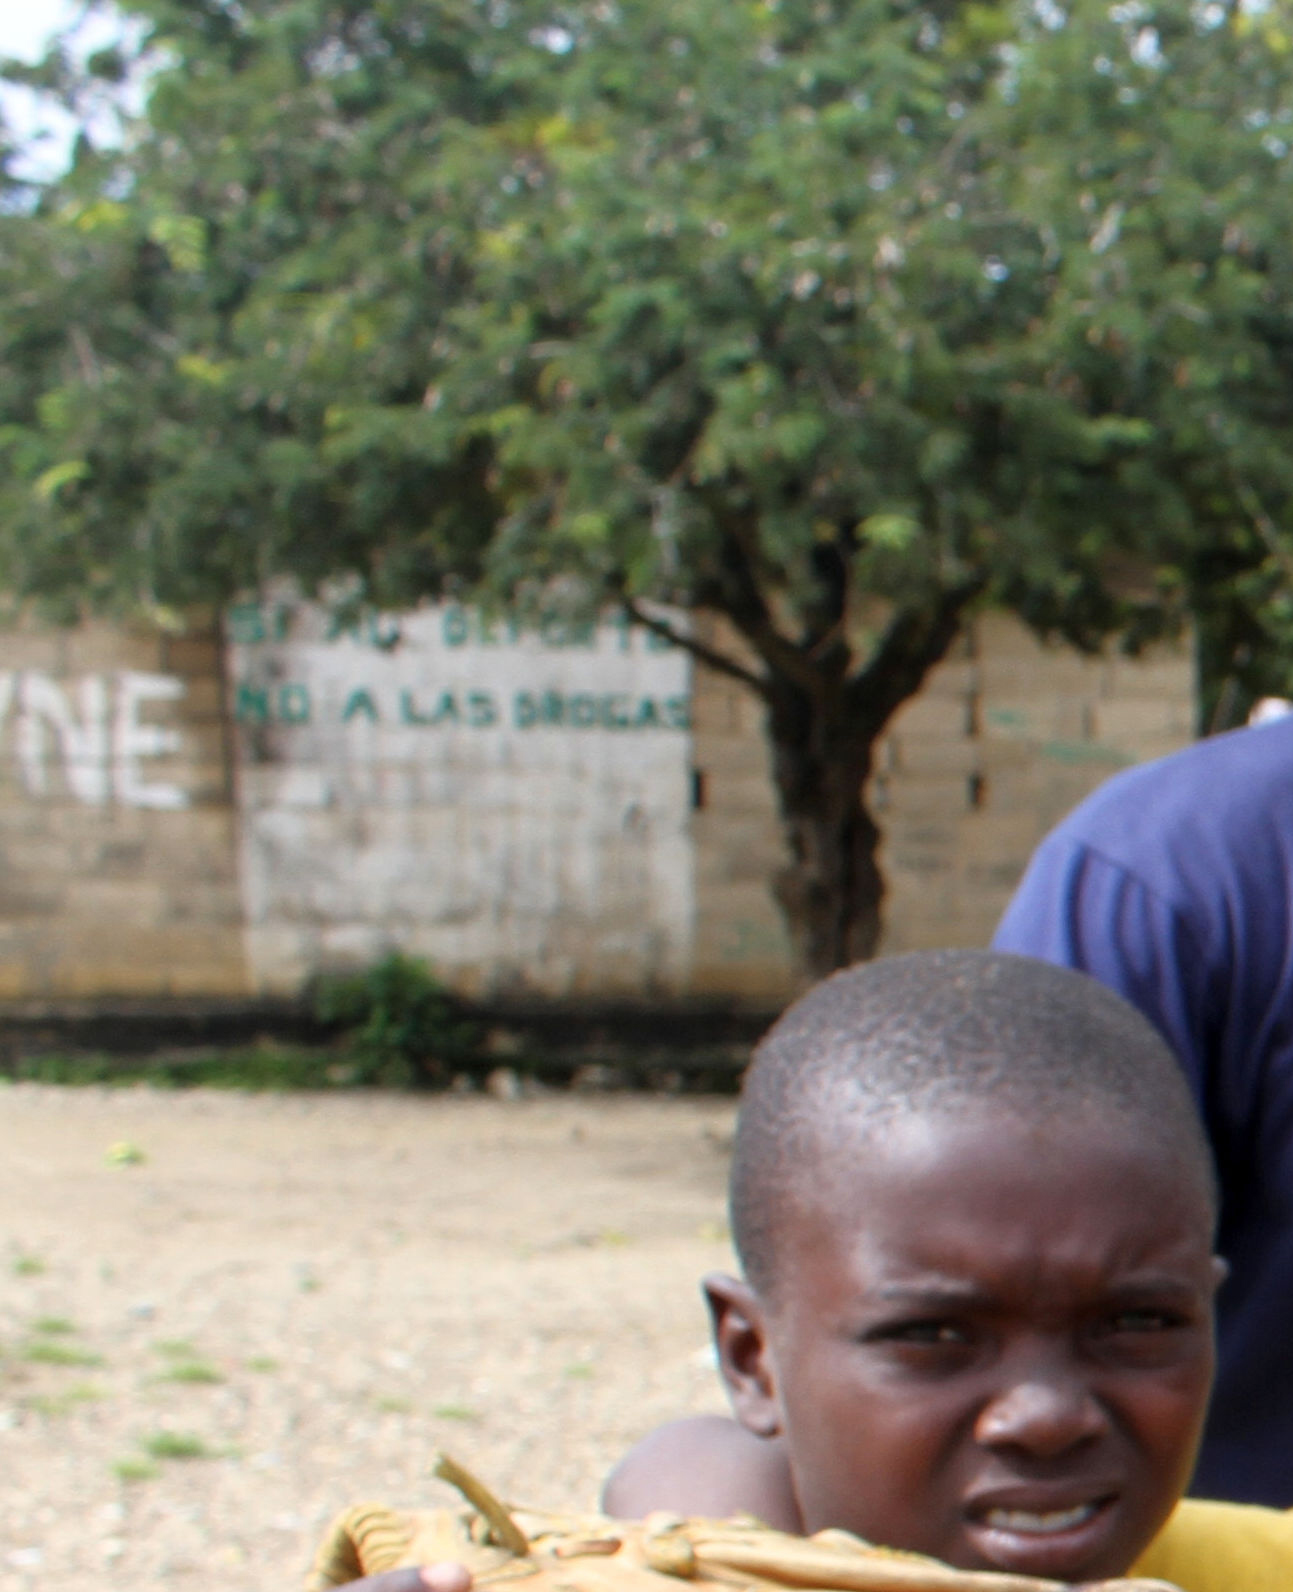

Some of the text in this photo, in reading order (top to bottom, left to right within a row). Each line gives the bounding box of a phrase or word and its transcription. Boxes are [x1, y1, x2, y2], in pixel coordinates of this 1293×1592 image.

[236, 684, 690, 730] NO A LAS DROGAS
